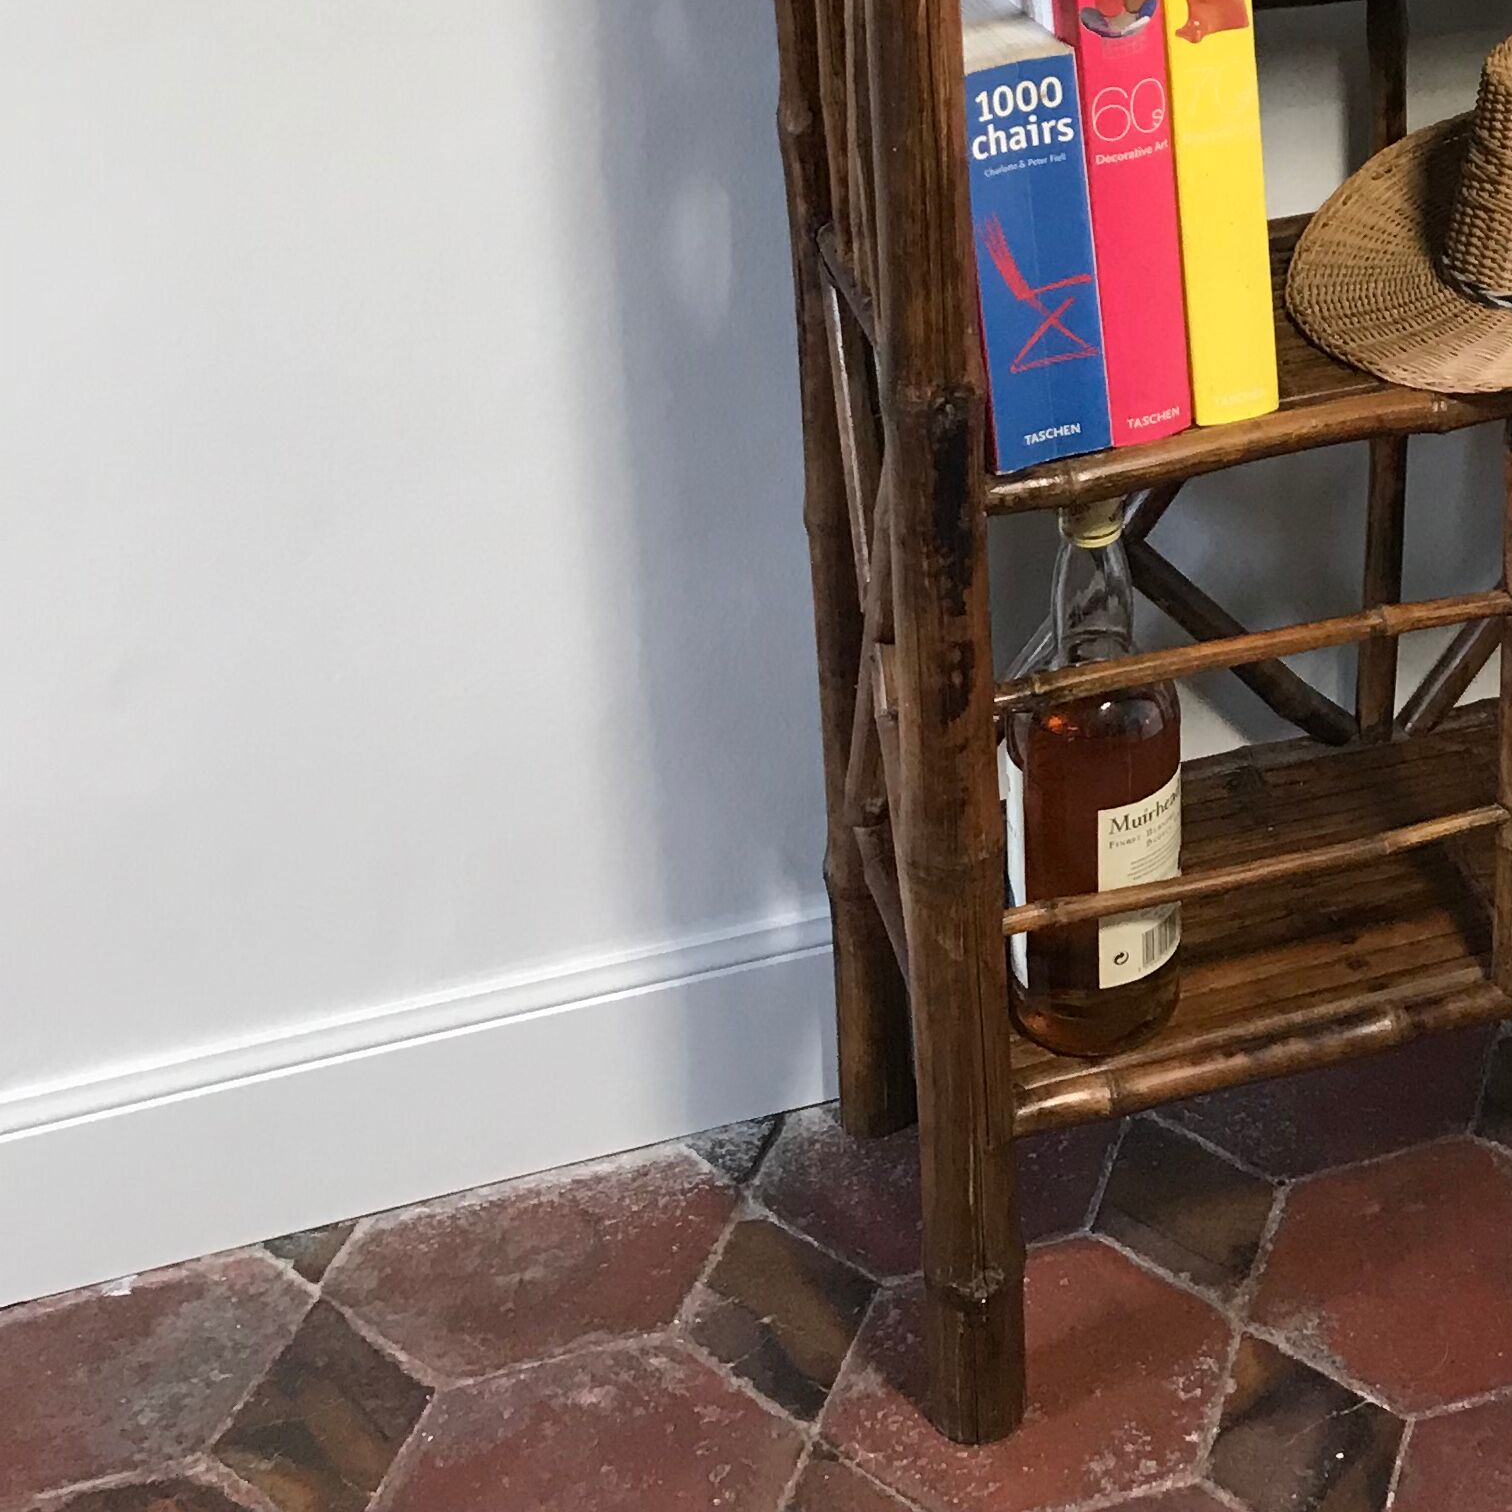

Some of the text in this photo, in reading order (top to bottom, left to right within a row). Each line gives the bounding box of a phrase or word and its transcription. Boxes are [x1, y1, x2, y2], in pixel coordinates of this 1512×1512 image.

[975, 76, 1063, 122] 1000
[1092, 78, 1165, 142] 60s
[972, 114, 1075, 160] chairs
[1018, 159, 1026, 170] &
[1027, 156, 1048, 167] Peter
[1095, 139, 1169, 166] Decorative Art
[1127, 406, 1181, 429] TASCHEN
[1023, 423, 1081, 446] TASCHEN
